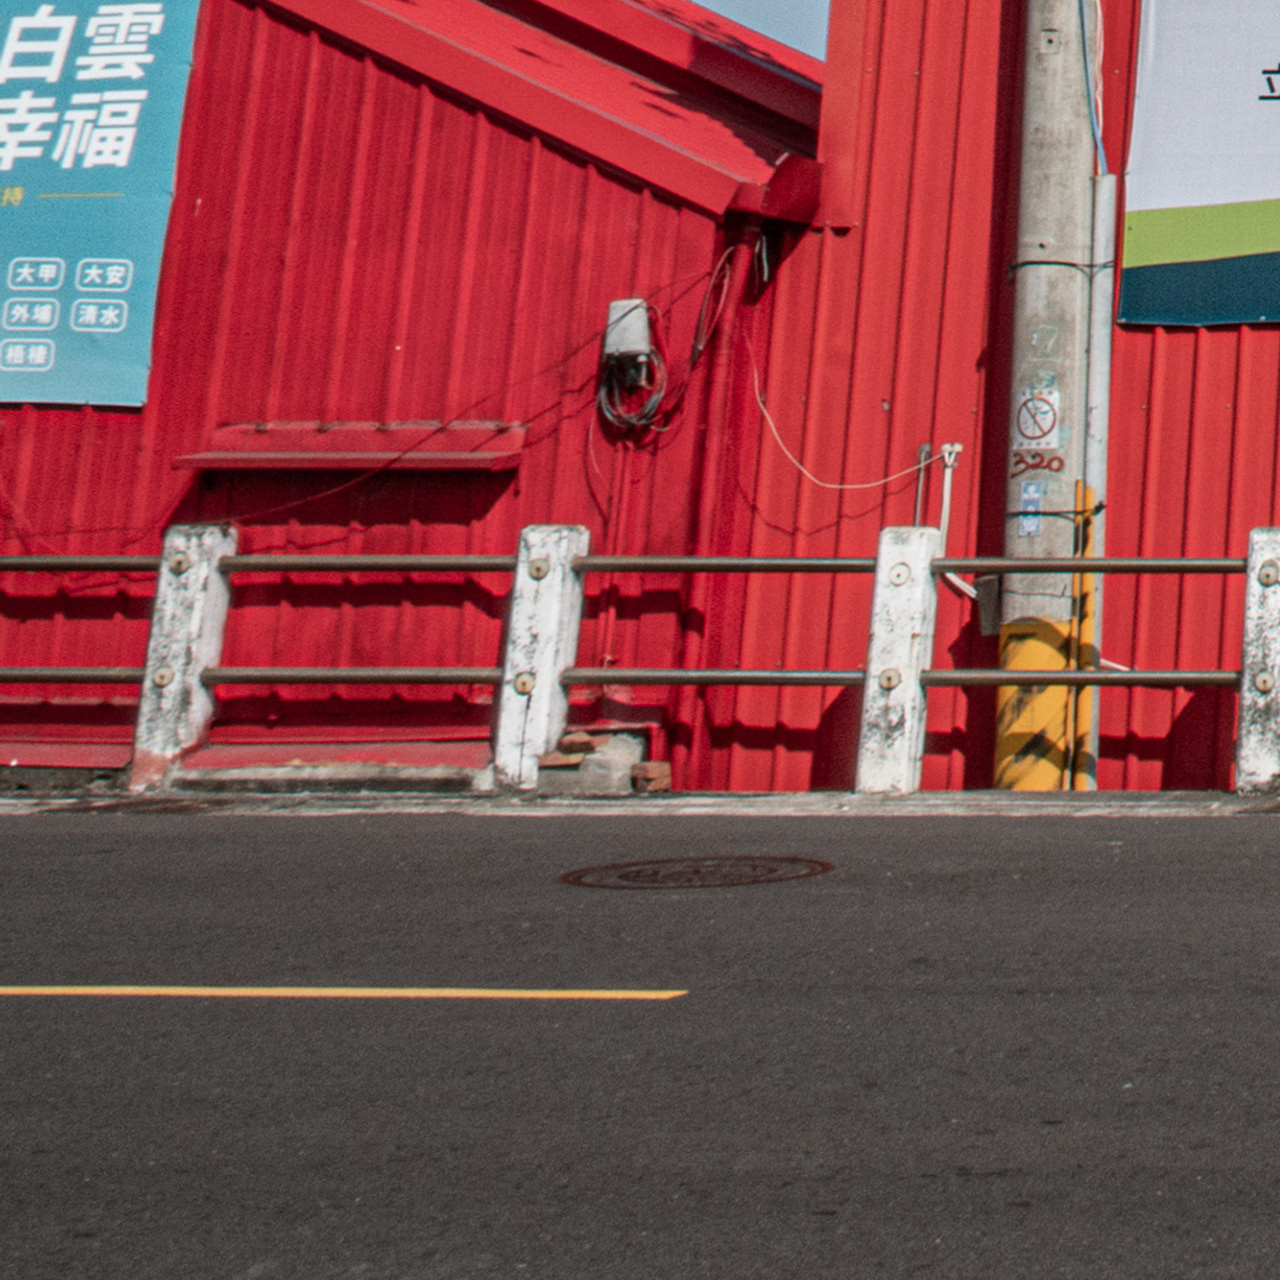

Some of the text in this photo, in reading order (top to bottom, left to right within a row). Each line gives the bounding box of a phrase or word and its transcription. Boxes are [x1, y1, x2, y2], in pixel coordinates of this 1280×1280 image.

[0, 3, 165, 84] 白雲
[0, 89, 149, 171] 幸福
[16, 264, 126, 285] 大甲 大安
[78, 305, 120, 326] 清水
